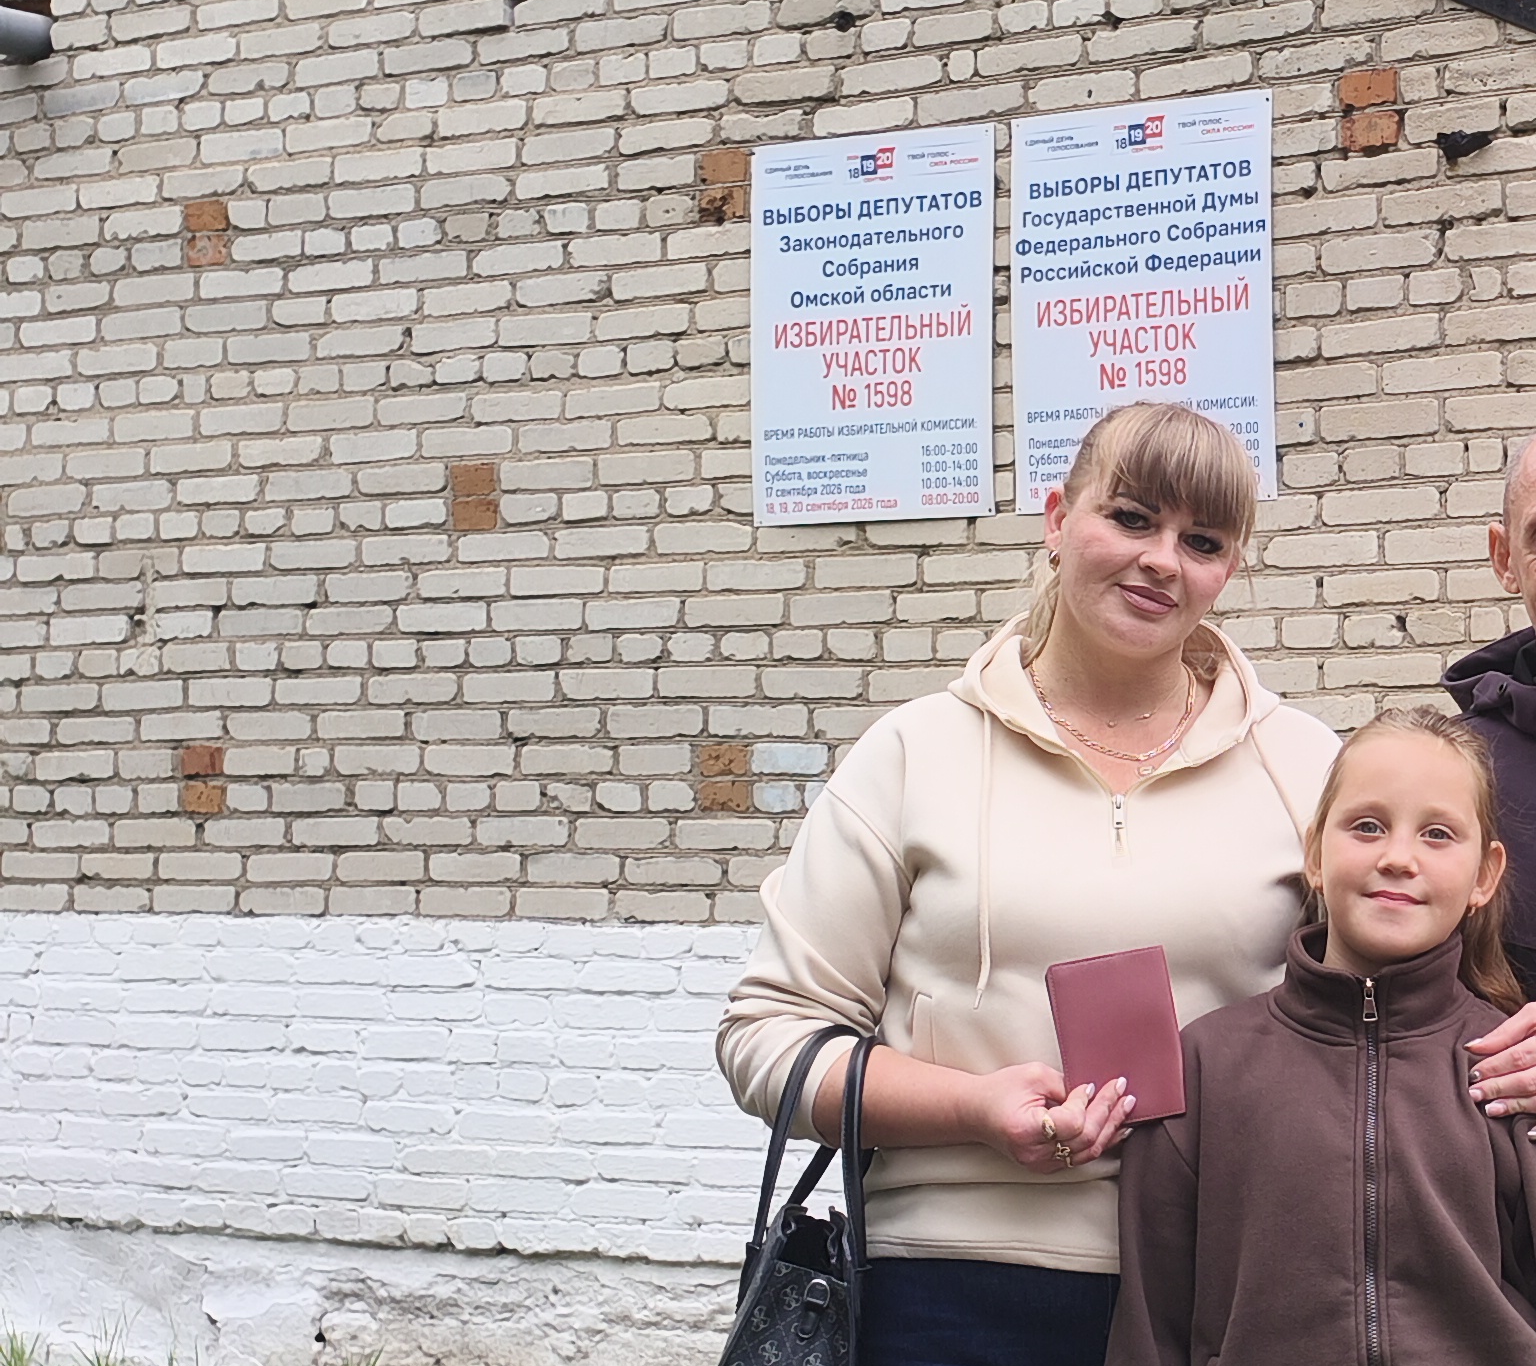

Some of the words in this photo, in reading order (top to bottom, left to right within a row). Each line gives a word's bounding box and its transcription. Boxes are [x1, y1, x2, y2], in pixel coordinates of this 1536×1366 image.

[1116, 138, 1127, 149] 18
[1130, 129, 1142, 142] 19
[1145, 121, 1161, 134] 20
[1178, 119, 1196, 129] ТВОЙ
[1198, 118, 1222, 126] ГОЛОС
[848, 168, 859, 179] 18
[862, 160, 874, 172] 19
[876, 152, 891, 165] 20
[1030, 174, 1120, 200] ВЫБОРЫ
[1126, 160, 1252, 192] ДЕПУТАТОВ
[763, 202, 851, 225] ВЫБОРЫ
[858, 191, 982, 221] ДЕПУТАТОВ
[1022, 194, 1196, 229] Государственной
[1202, 191, 1258, 213] Думы
[780, 225, 963, 252] Законодательного
[1015, 229, 1160, 257] Федерального
[1167, 219, 1266, 242] Собрания
[822, 257, 919, 279] Собрания
[1020, 256, 1138, 283] Российской
[1145, 248, 1261, 272] Федерации
[791, 286, 864, 308] Омской
[870, 283, 951, 303] области
[1036, 276, 1249, 328] ИЗБИРАТЕЛЬНЫЙ
[774, 303, 972, 349] ИЗБИРАТЕЛЬНЫЙ
[1089, 322, 1196, 357] УЧАСТОК
[822, 347, 922, 379] УЧАСТОК
[1100, 362, 1126, 390] №
[1135, 357, 1187, 387] 1598
[832, 384, 856, 410] №
[864, 380, 912, 408] 1598
[1028, 410, 1060, 423] ВРЕМЯ
[1064, 407, 1103, 420] РАБОТЫ
[1196, 396, 1258, 411] КОМИССИИ:
[764, 429, 794, 441] ВРЕМЯ
[798, 426, 834, 439] РАБОТЫ
[838, 419, 917, 436] ИЗБИРАТЕЛЬНОЙ
[921, 418, 977, 431] КОМИССИИ:
[922, 443, 978, 457] 16:00-20:00
[807, 468, 868, 480] воскресенье
[922, 459, 978, 473] 10:00-14:00
[1030, 471, 1037, 483] 17
[766, 487, 773, 497] 17
[776, 485, 817, 498] сентября
[820, 484, 842, 495] 2026
[845, 484, 866, 494] года
[922, 475, 978, 489] 10:00-14:00
[806, 499, 848, 513] сентября
[851, 498, 873, 509] 2026
[876, 499, 898, 509] года
